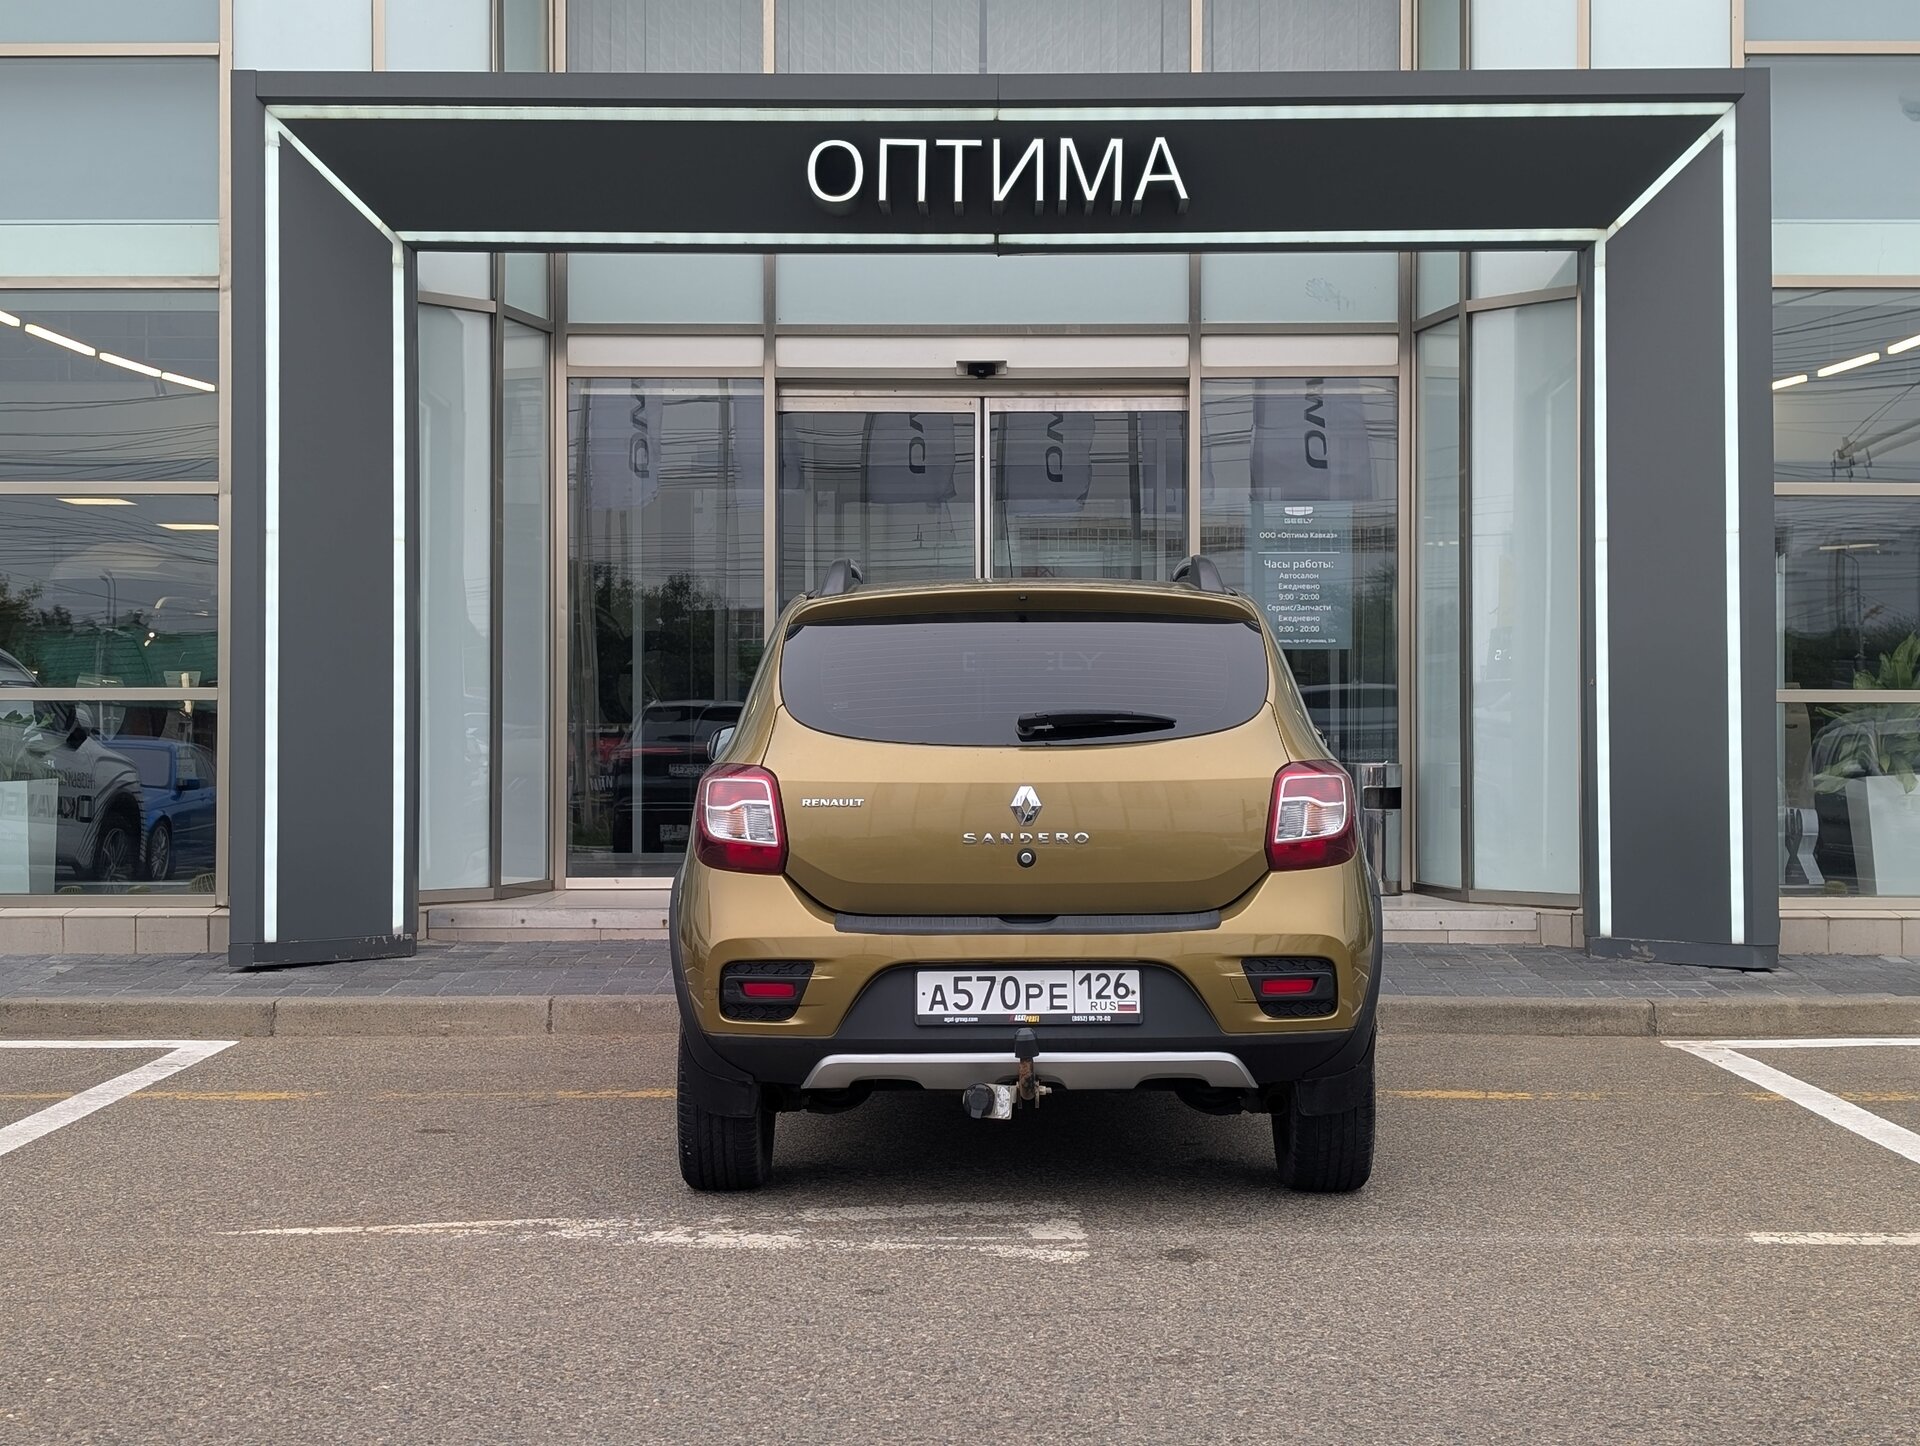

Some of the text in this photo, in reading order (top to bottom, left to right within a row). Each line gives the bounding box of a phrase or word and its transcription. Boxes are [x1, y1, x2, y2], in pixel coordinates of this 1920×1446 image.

[806, 136, 1190, 203] ОПТИМА
[1264, 559, 1334, 570] Часы работы:
[1266, 604, 1332, 612] Сервис/Запчасти
[801, 798, 865, 808] RENAULT
[962, 832, 1090, 845] SANDERO
[928, 972, 1131, 1012] А570РЕ 126
[1090, 1001, 1117, 1011] RUS
